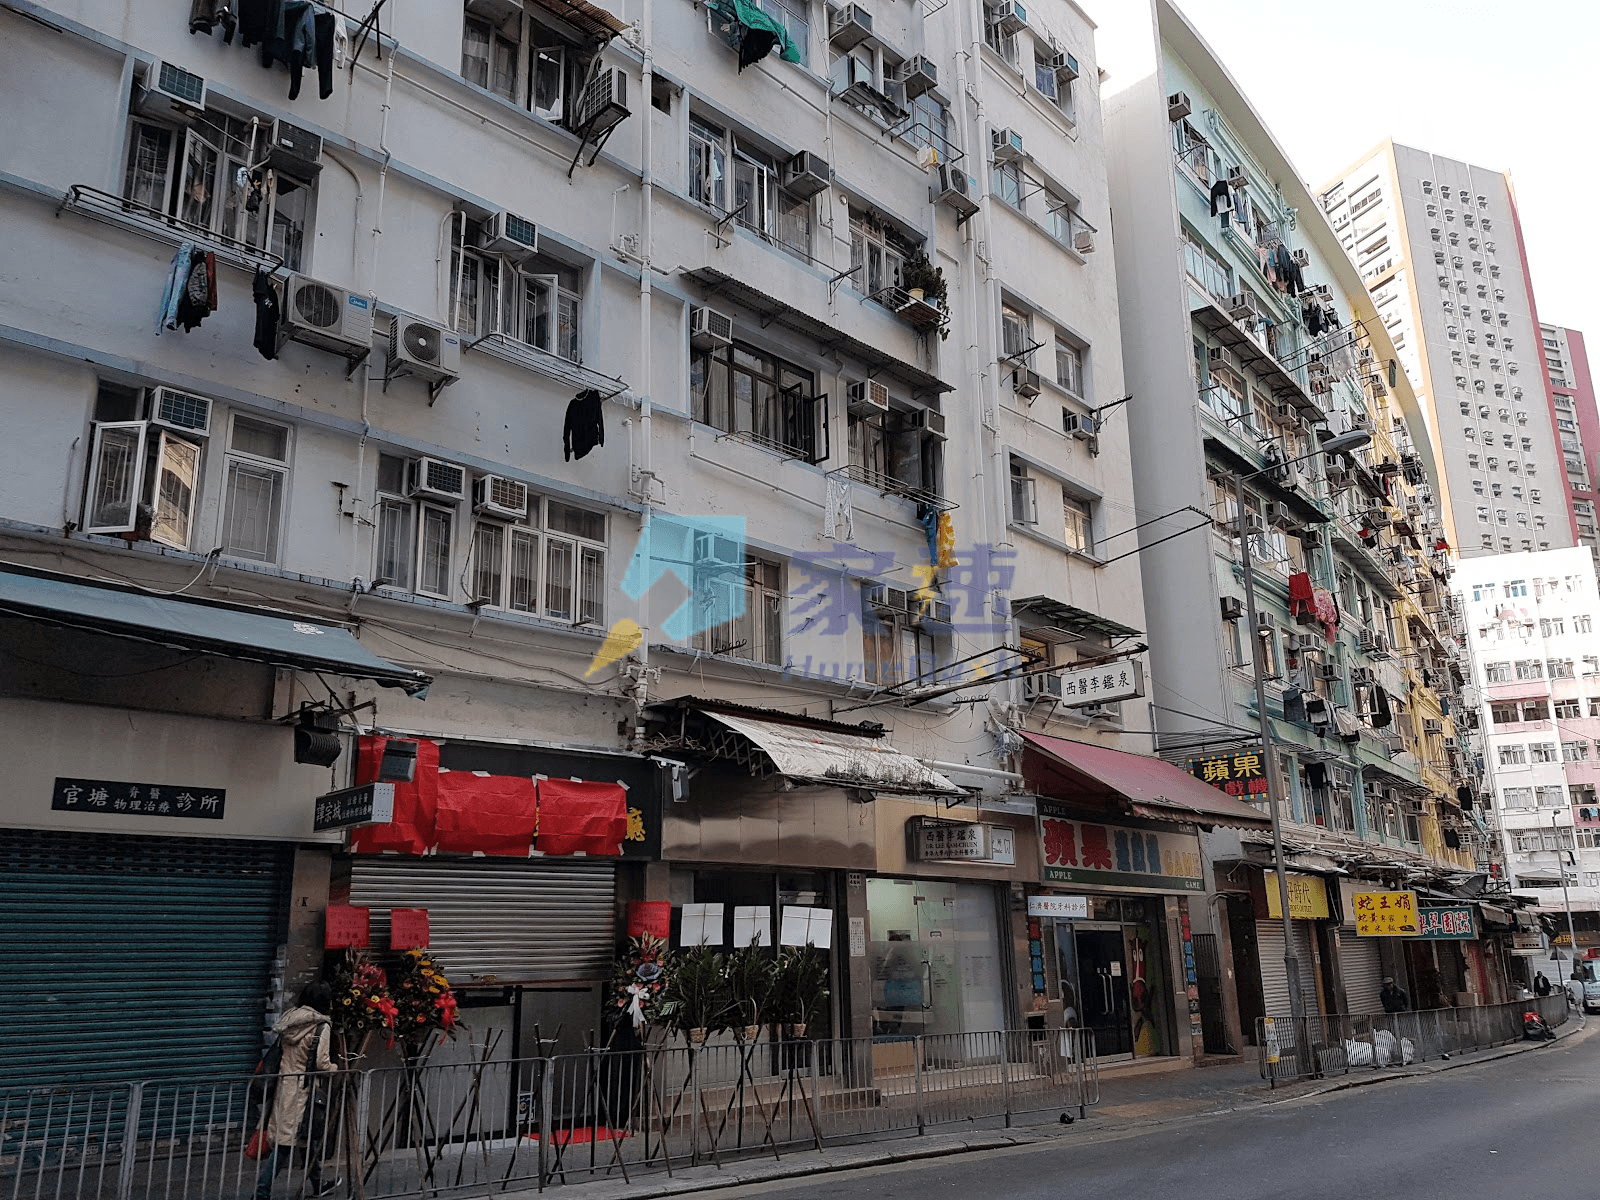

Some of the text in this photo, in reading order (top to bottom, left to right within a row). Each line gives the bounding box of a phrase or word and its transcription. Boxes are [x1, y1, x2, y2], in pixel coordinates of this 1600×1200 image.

[1066, 670, 1130, 695] 西醫李鑑泉
[1202, 755, 1262, 782] 蘋果
[63, 785, 110, 807] 官塘
[114, 798, 172, 813] 物理治療
[176, 792, 220, 813] 診所
[1043, 804, 1066, 816] APPLE
[1043, 819, 1112, 870] 蘋果
[1163, 850, 1201, 878] GAME
[1049, 870, 1073, 881] APPLE
[1185, 881, 1201, 889] GAME
[1358, 894, 1411, 911] 蛇王娟
